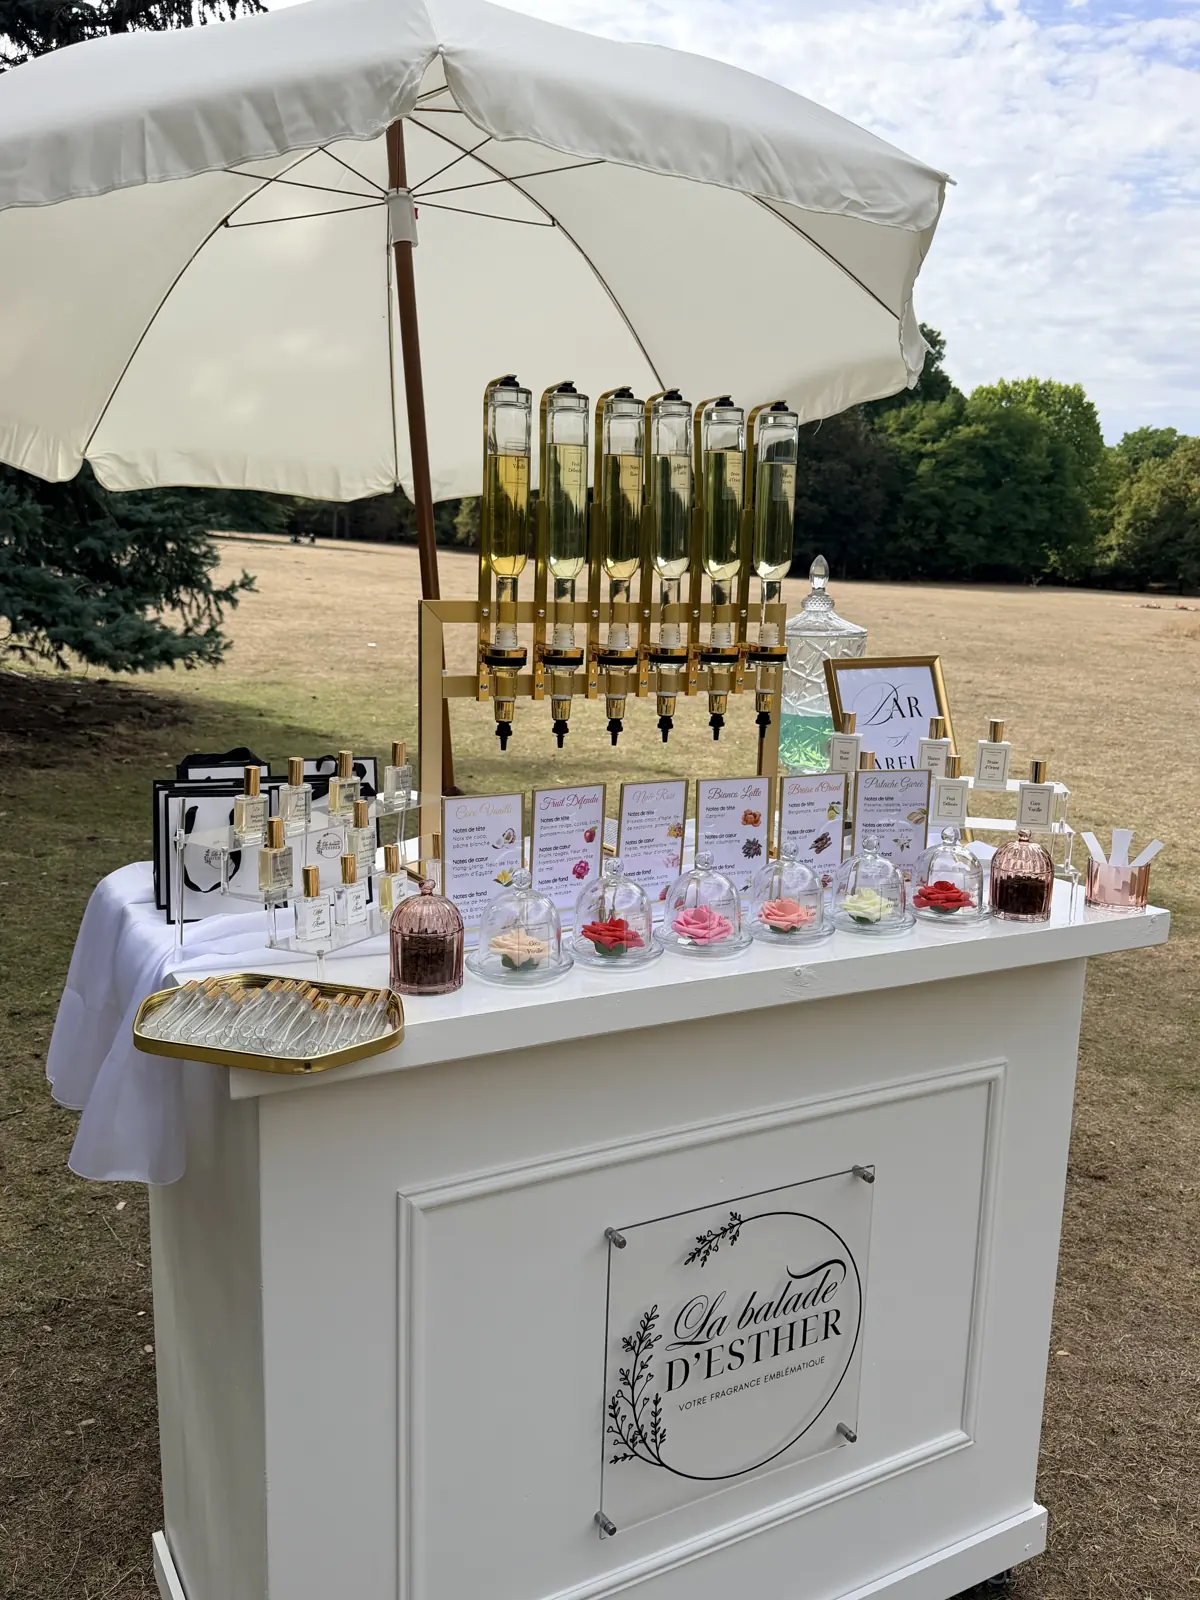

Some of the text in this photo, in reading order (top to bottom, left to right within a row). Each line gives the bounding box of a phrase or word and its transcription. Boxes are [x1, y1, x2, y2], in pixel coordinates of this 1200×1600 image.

[708, 785, 762, 801] Bianca Latte
[787, 780, 842, 795] Braise d'Orient
[863, 776, 924, 793] Pistache Givrée
[539, 793, 599, 811] Fruit Défendu
[470, 840, 490, 848] blanche
[665, 1258, 847, 1352] La balade
[665, 1308, 842, 1392] D'ESTHER
[678, 1355, 826, 1412] VOTRE FRAGRANCE EMBLÉMATIQUE
